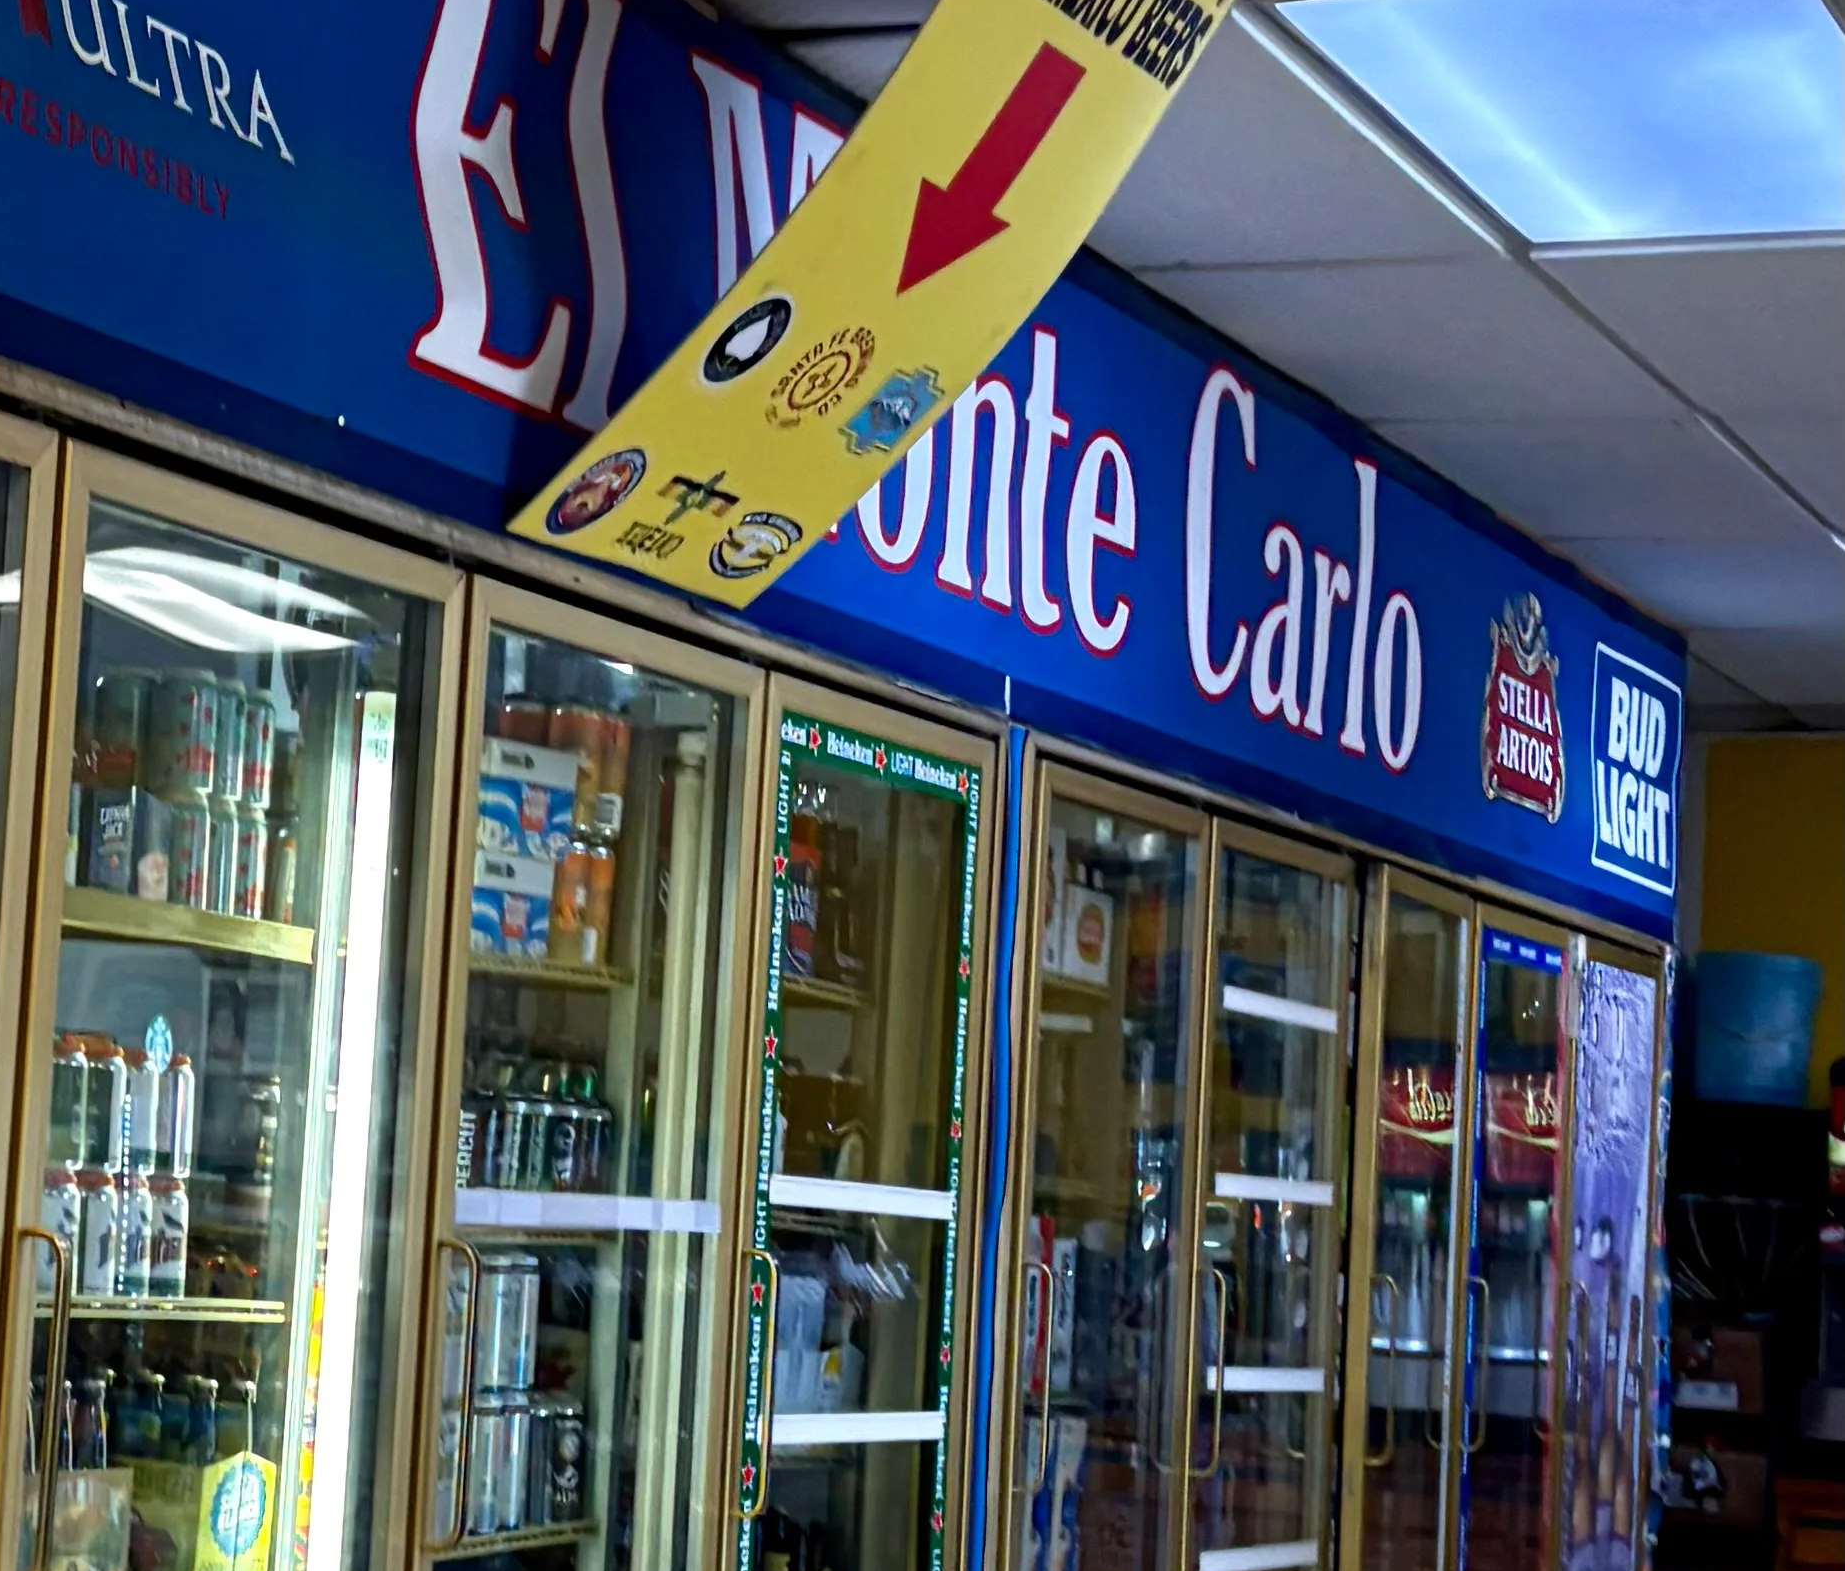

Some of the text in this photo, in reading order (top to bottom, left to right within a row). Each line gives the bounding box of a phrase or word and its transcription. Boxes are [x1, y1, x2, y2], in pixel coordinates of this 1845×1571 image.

[1184, 362, 1422, 773] Carlo
[827, 731, 873, 767] Heineken
[1497, 724, 1553, 785] ARTOIS
[1498, 673, 1553, 735] STELLA
[1608, 677, 1666, 778] BUD
[778, 773, 789, 834] LIGHT
[914, 758, 957, 790] Heineken
[1597, 759, 1670, 869] LIGHT
[962, 834, 977, 947] Heineken
[767, 885, 784, 1011] Heineken
[954, 997, 968, 1107] Heineken
[758, 1065, 775, 1191] Heineken
